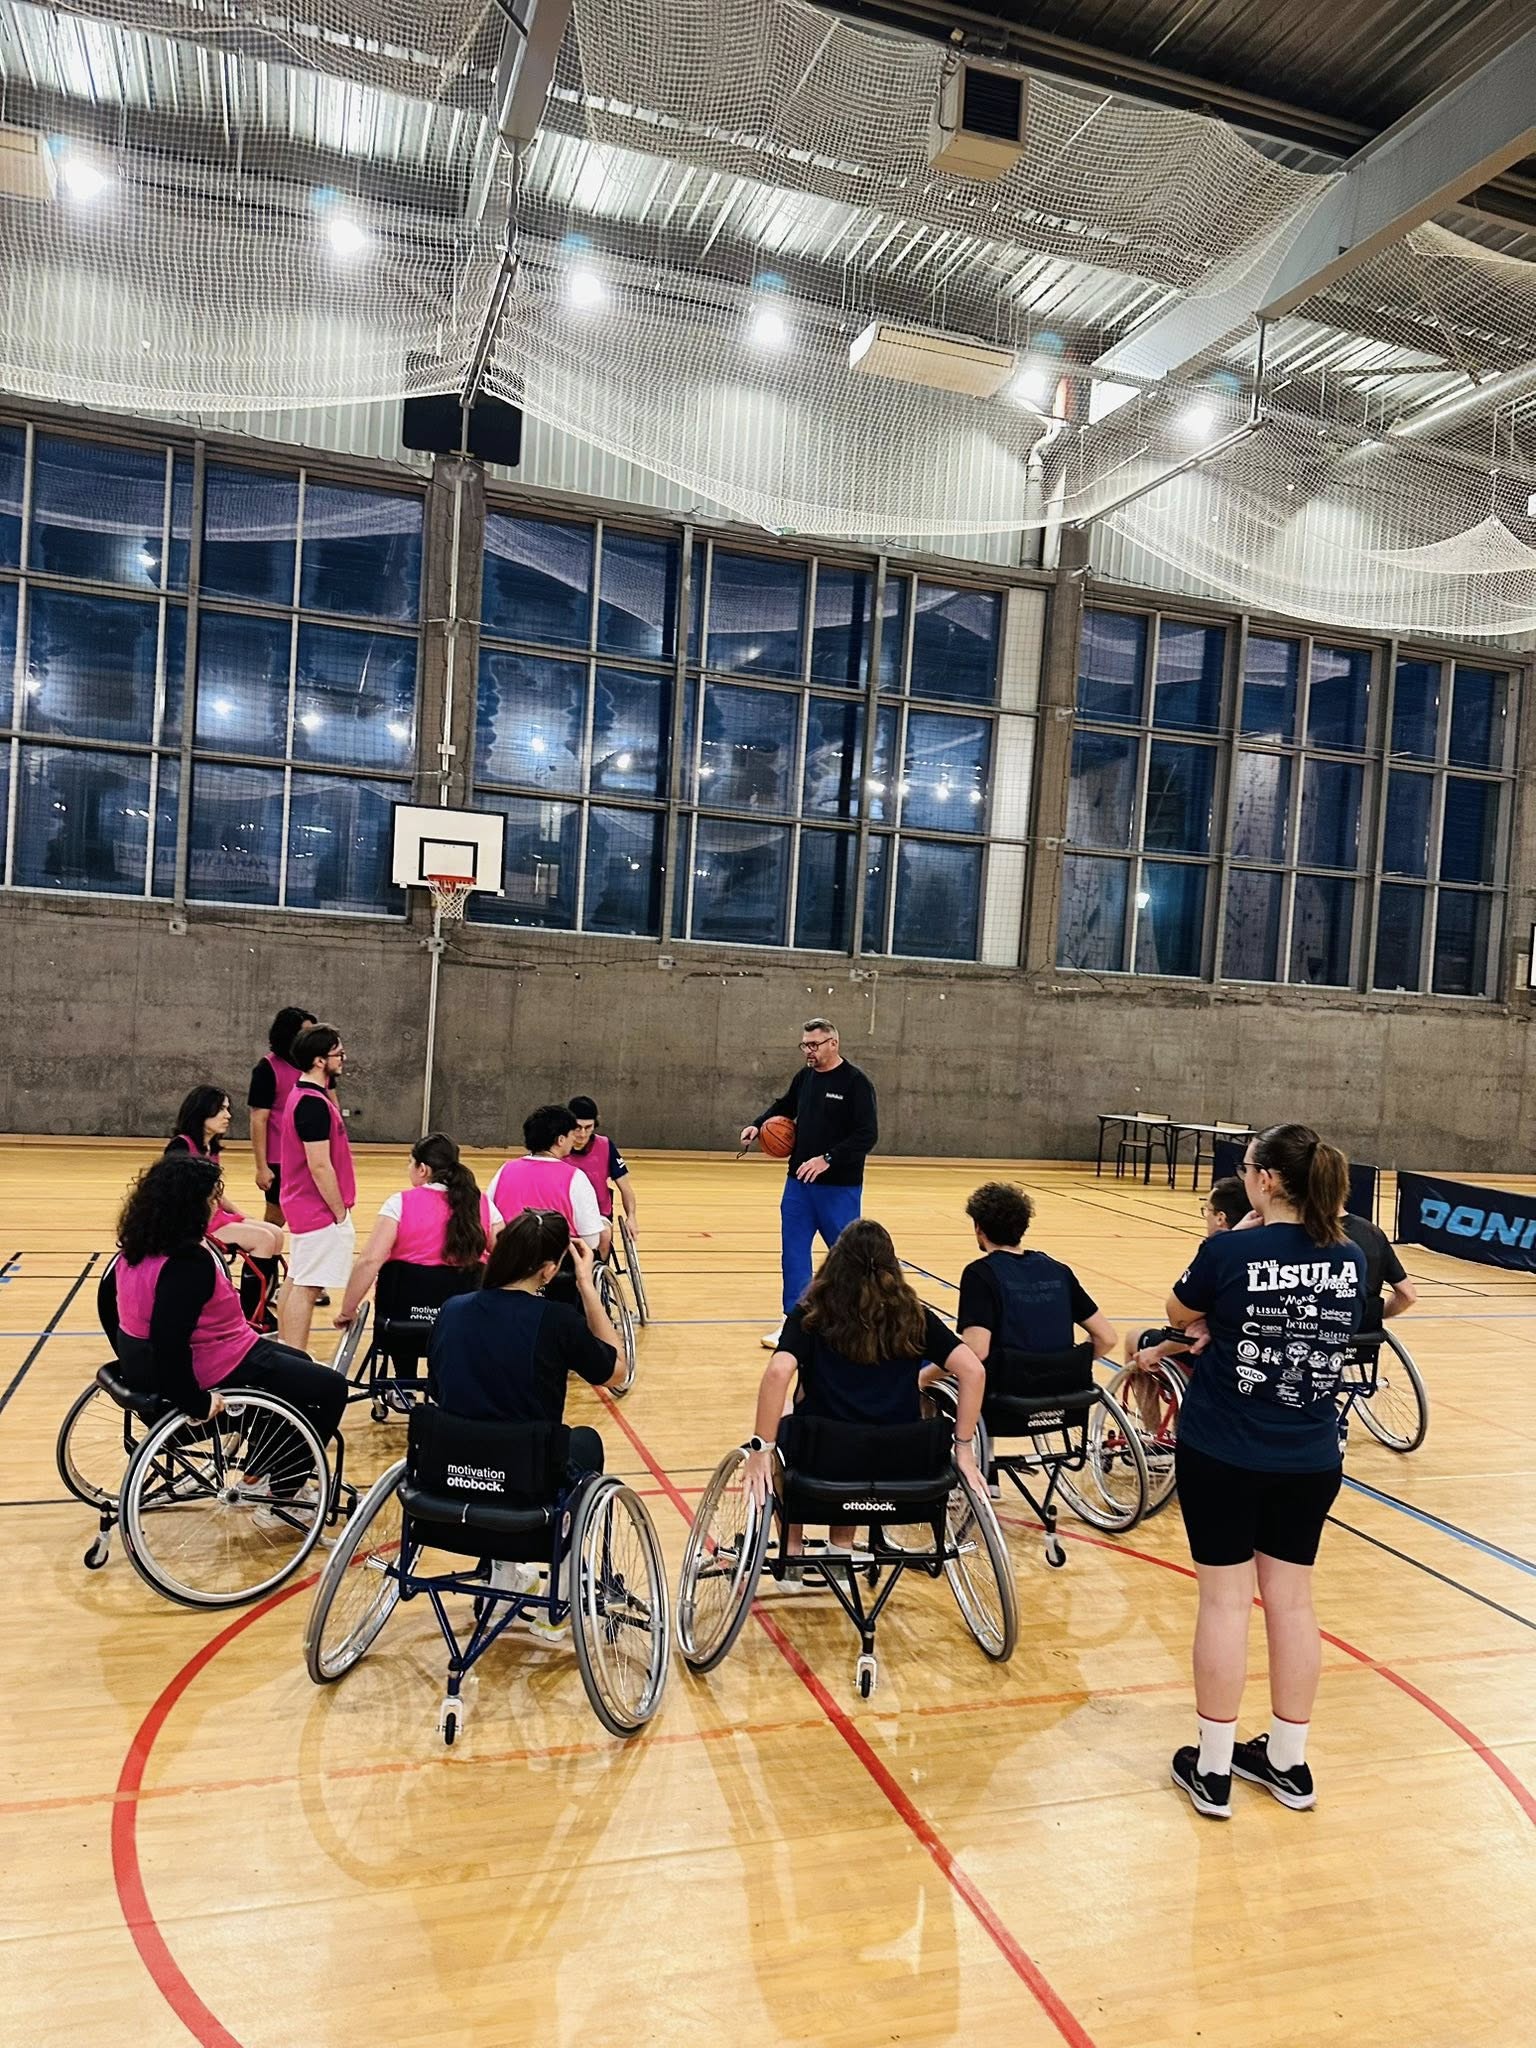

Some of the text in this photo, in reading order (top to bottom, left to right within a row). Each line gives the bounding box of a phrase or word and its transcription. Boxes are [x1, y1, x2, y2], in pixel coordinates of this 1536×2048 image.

[1247, 1260, 1279, 1270] TRAIL
[1247, 1262, 1358, 1292] LISULA
[1335, 1288, 1357, 1298] 2025
[1256, 1306, 1288, 1314] LISULA
[448, 1464, 505, 1480] motivation
[447, 1476, 505, 1493] ottobock.
[842, 1501, 896, 1512] ottobock.
